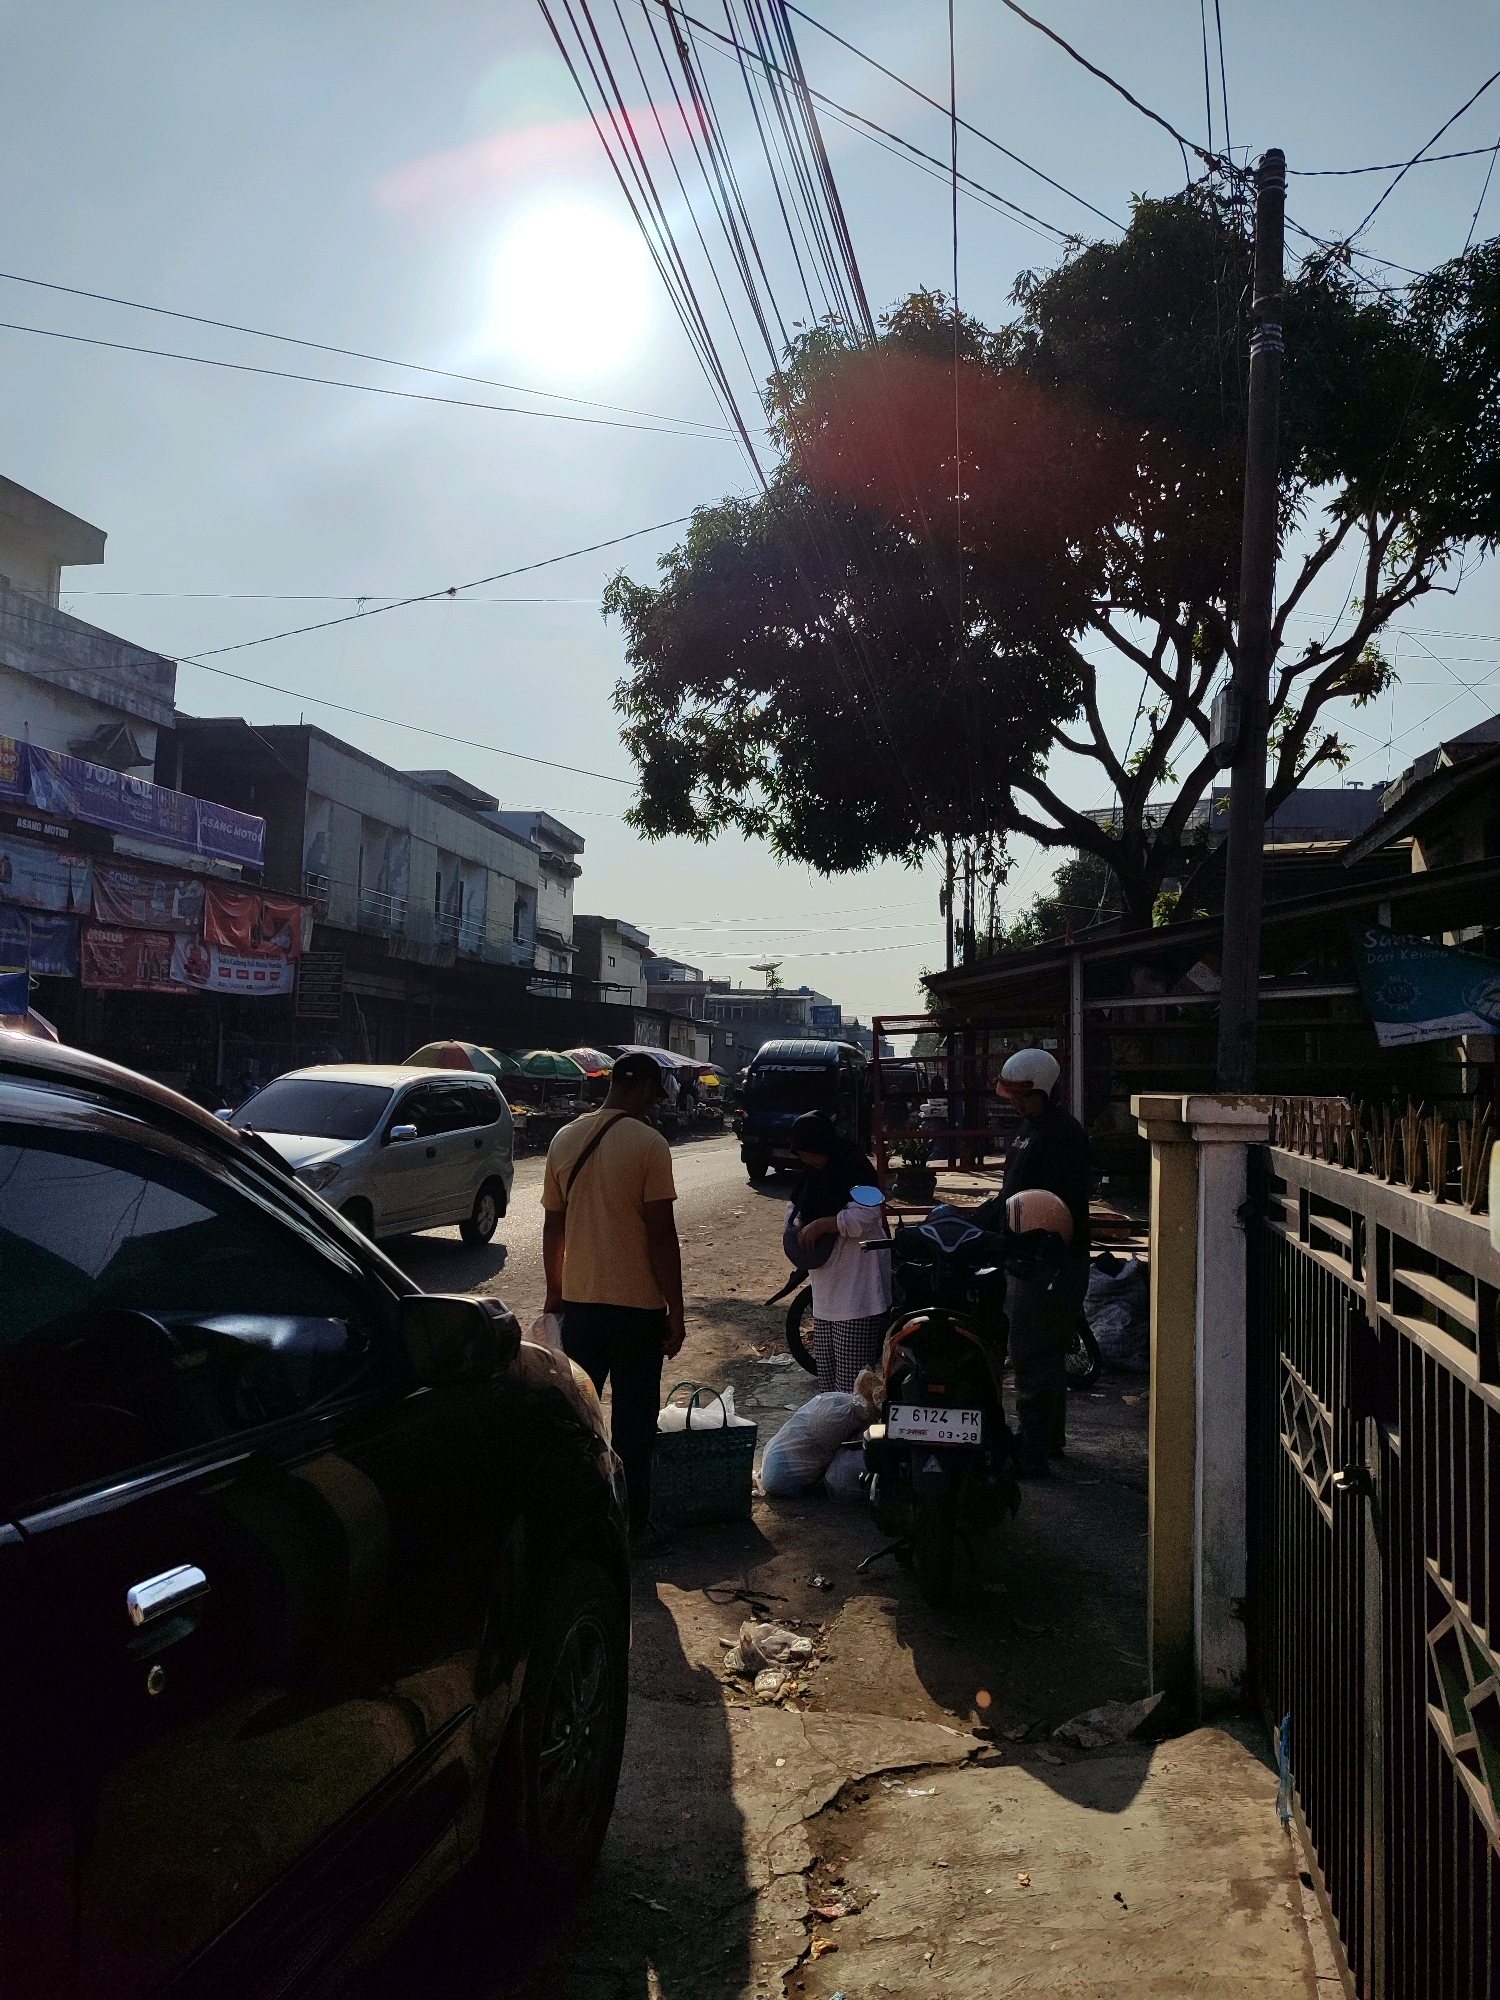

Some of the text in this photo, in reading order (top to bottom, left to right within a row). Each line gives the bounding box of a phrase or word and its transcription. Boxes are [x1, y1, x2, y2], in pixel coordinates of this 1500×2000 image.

[16, 817, 70, 839] ASANG MOTOR
[202, 816, 233, 834] ASANG
[891, 1407, 979, 1426] Z 6124 FK
